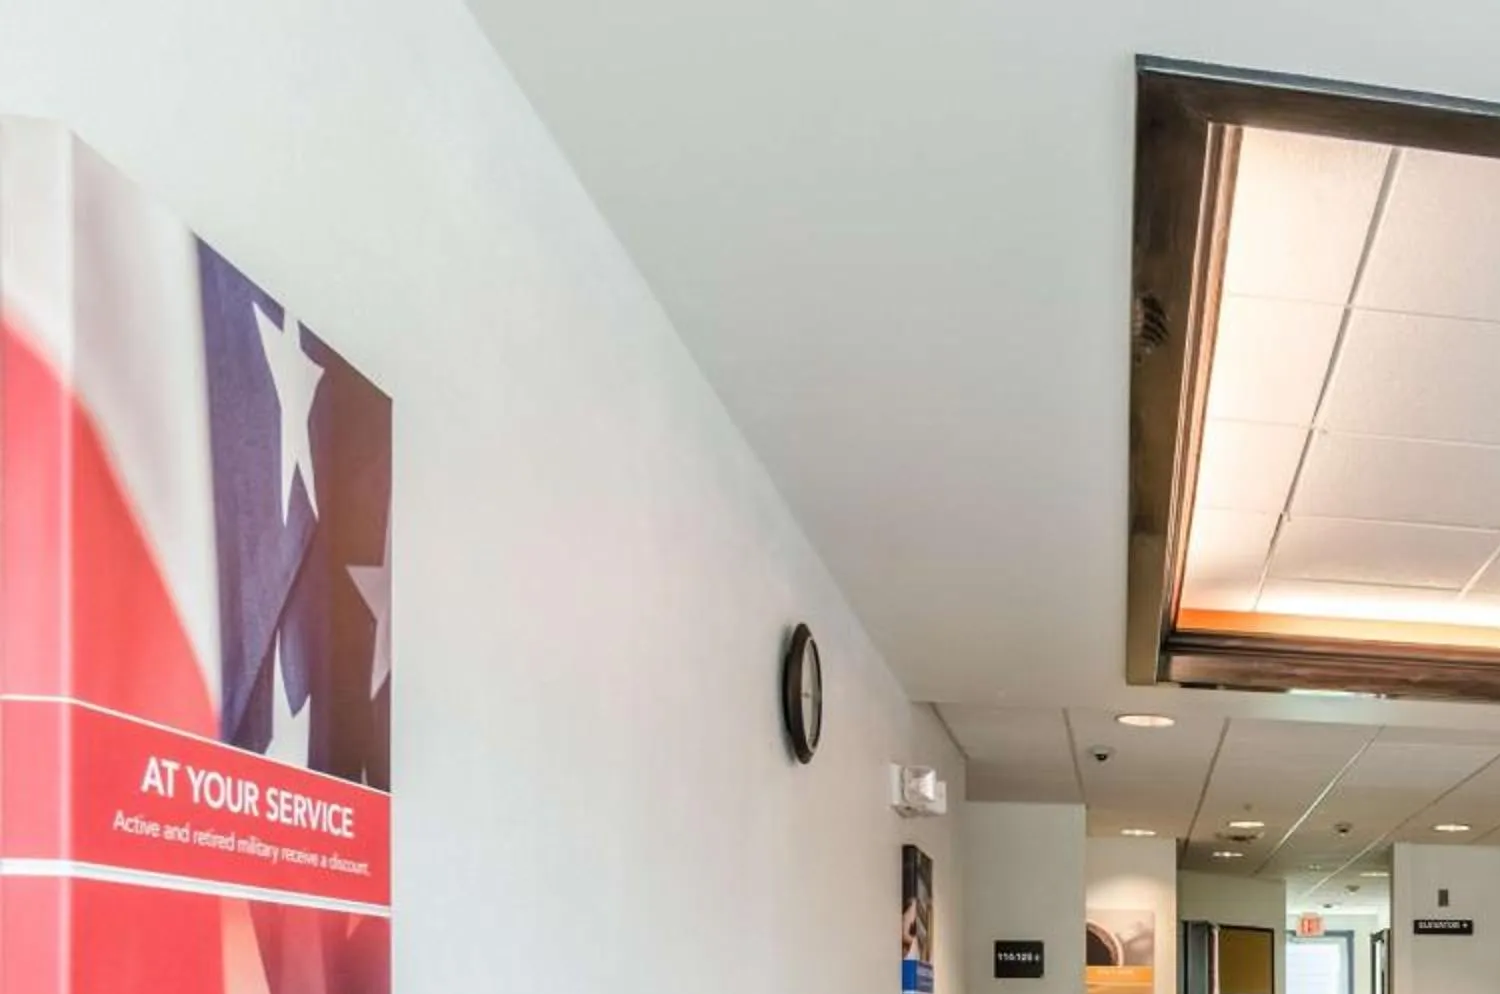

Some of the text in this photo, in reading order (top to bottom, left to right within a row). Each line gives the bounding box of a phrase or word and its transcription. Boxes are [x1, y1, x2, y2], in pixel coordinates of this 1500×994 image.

[141, 756, 355, 839] AT YOUR SERVICE
[113, 809, 160, 838] Active
[163, 822, 190, 843] and
[193, 831, 235, 852] retired
[237, 836, 279, 865] military
[281, 847, 319, 867] receive
[320, 855, 327, 868] a
